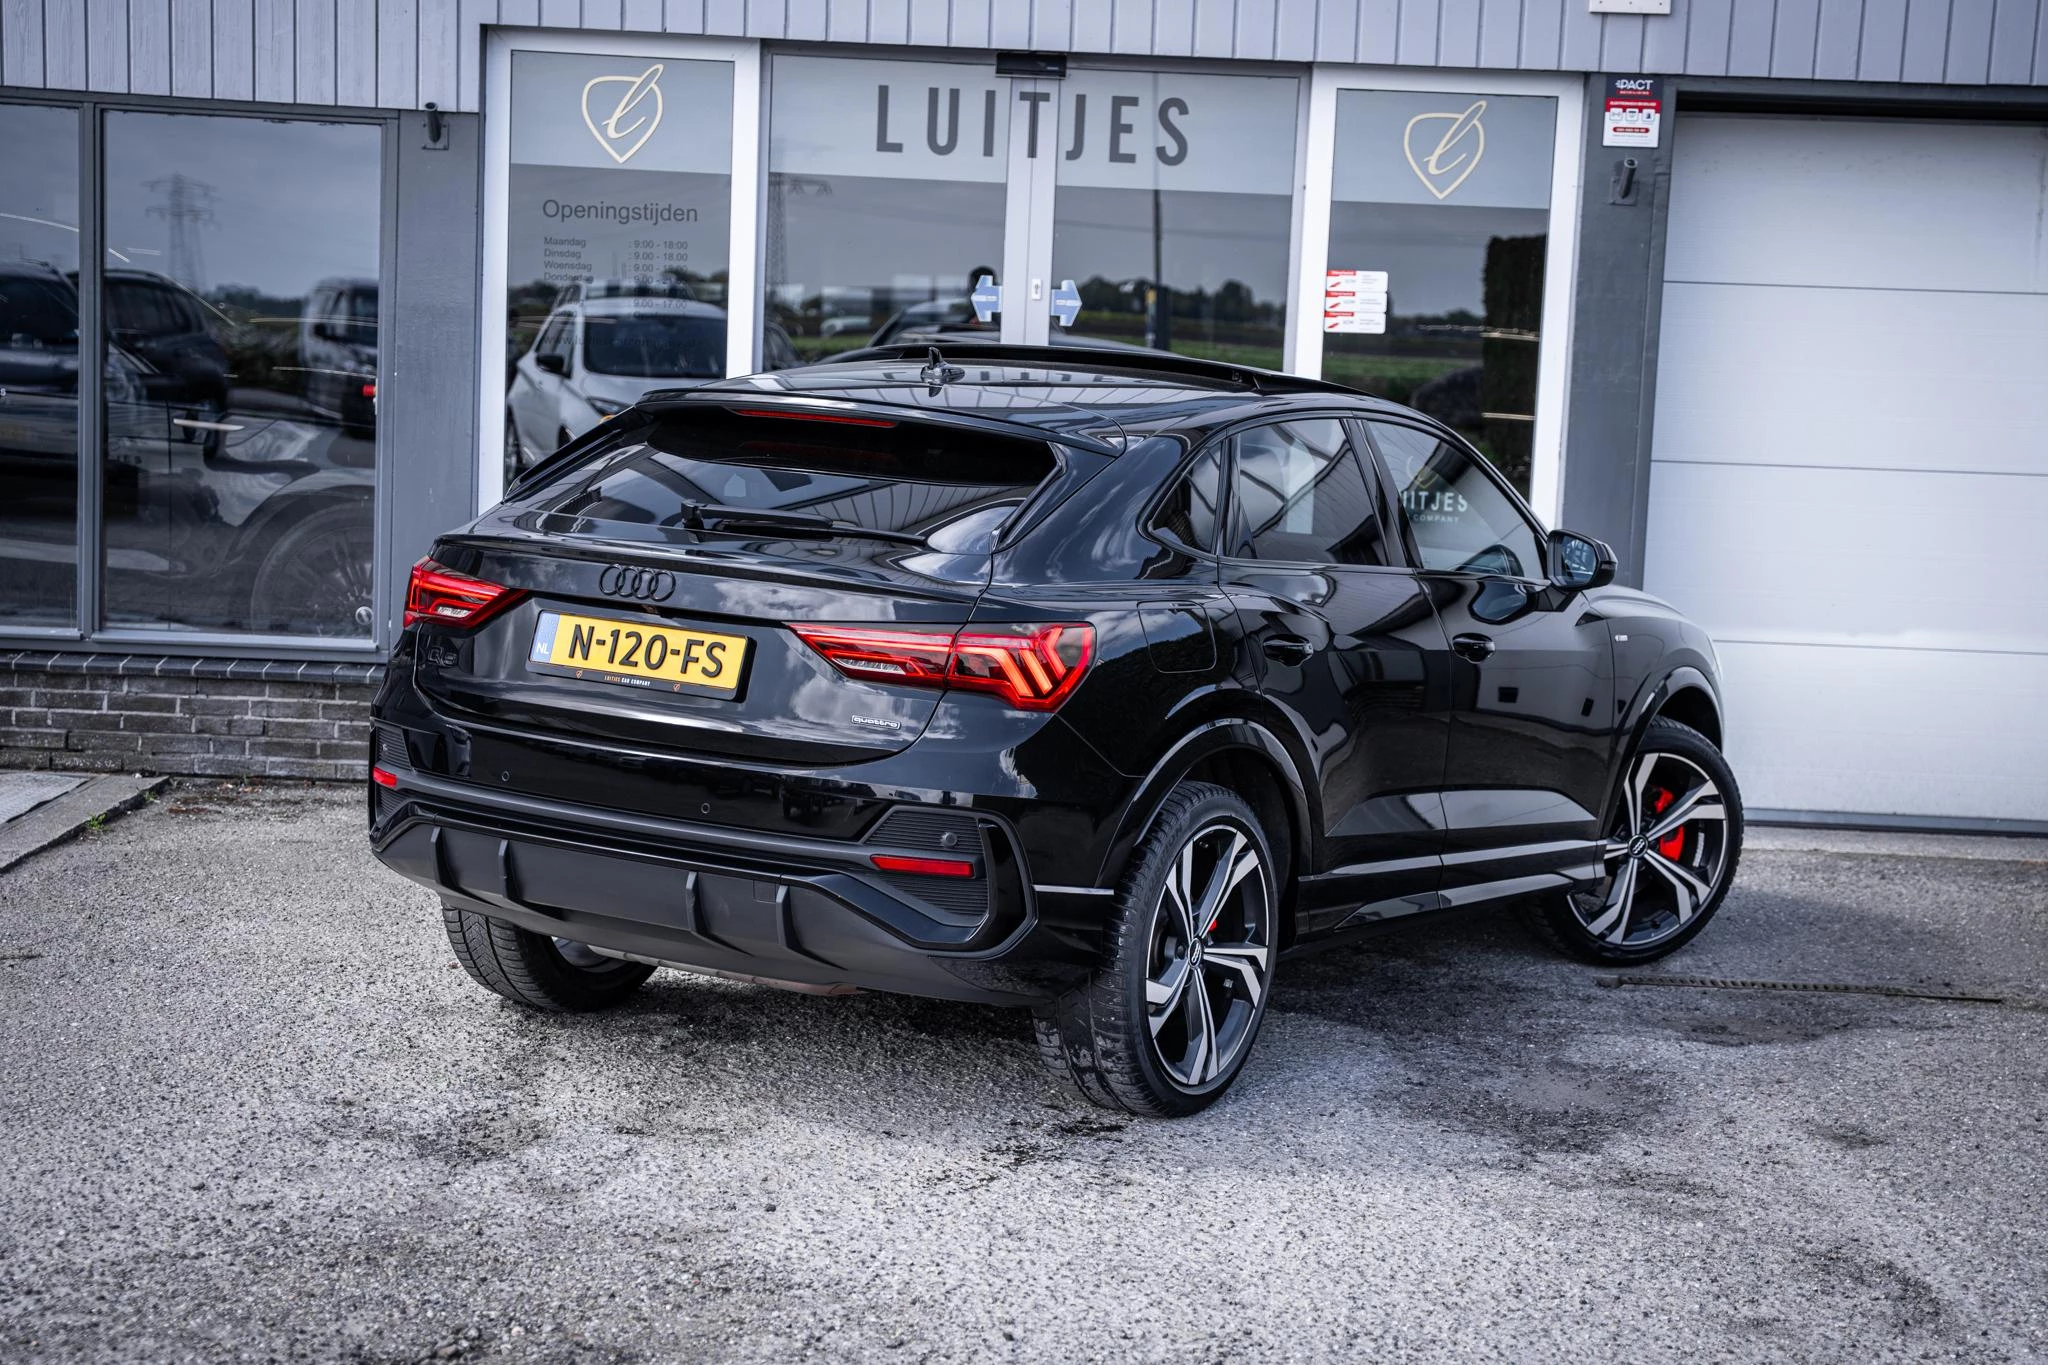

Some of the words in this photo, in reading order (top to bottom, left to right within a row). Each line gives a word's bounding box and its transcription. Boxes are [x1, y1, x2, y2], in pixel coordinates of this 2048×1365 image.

[876, 85, 1189, 166] LUITJES
[542, 200, 698, 225] Openingstijden
[544, 236, 586, 248] Maandag
[544, 248, 581, 260] Dinsdag
[544, 260, 592, 272] Woensdag
[536, 641, 550, 655] NL
[568, 624, 726, 678] N-120-FS
[854, 716, 897, 728] quattro
